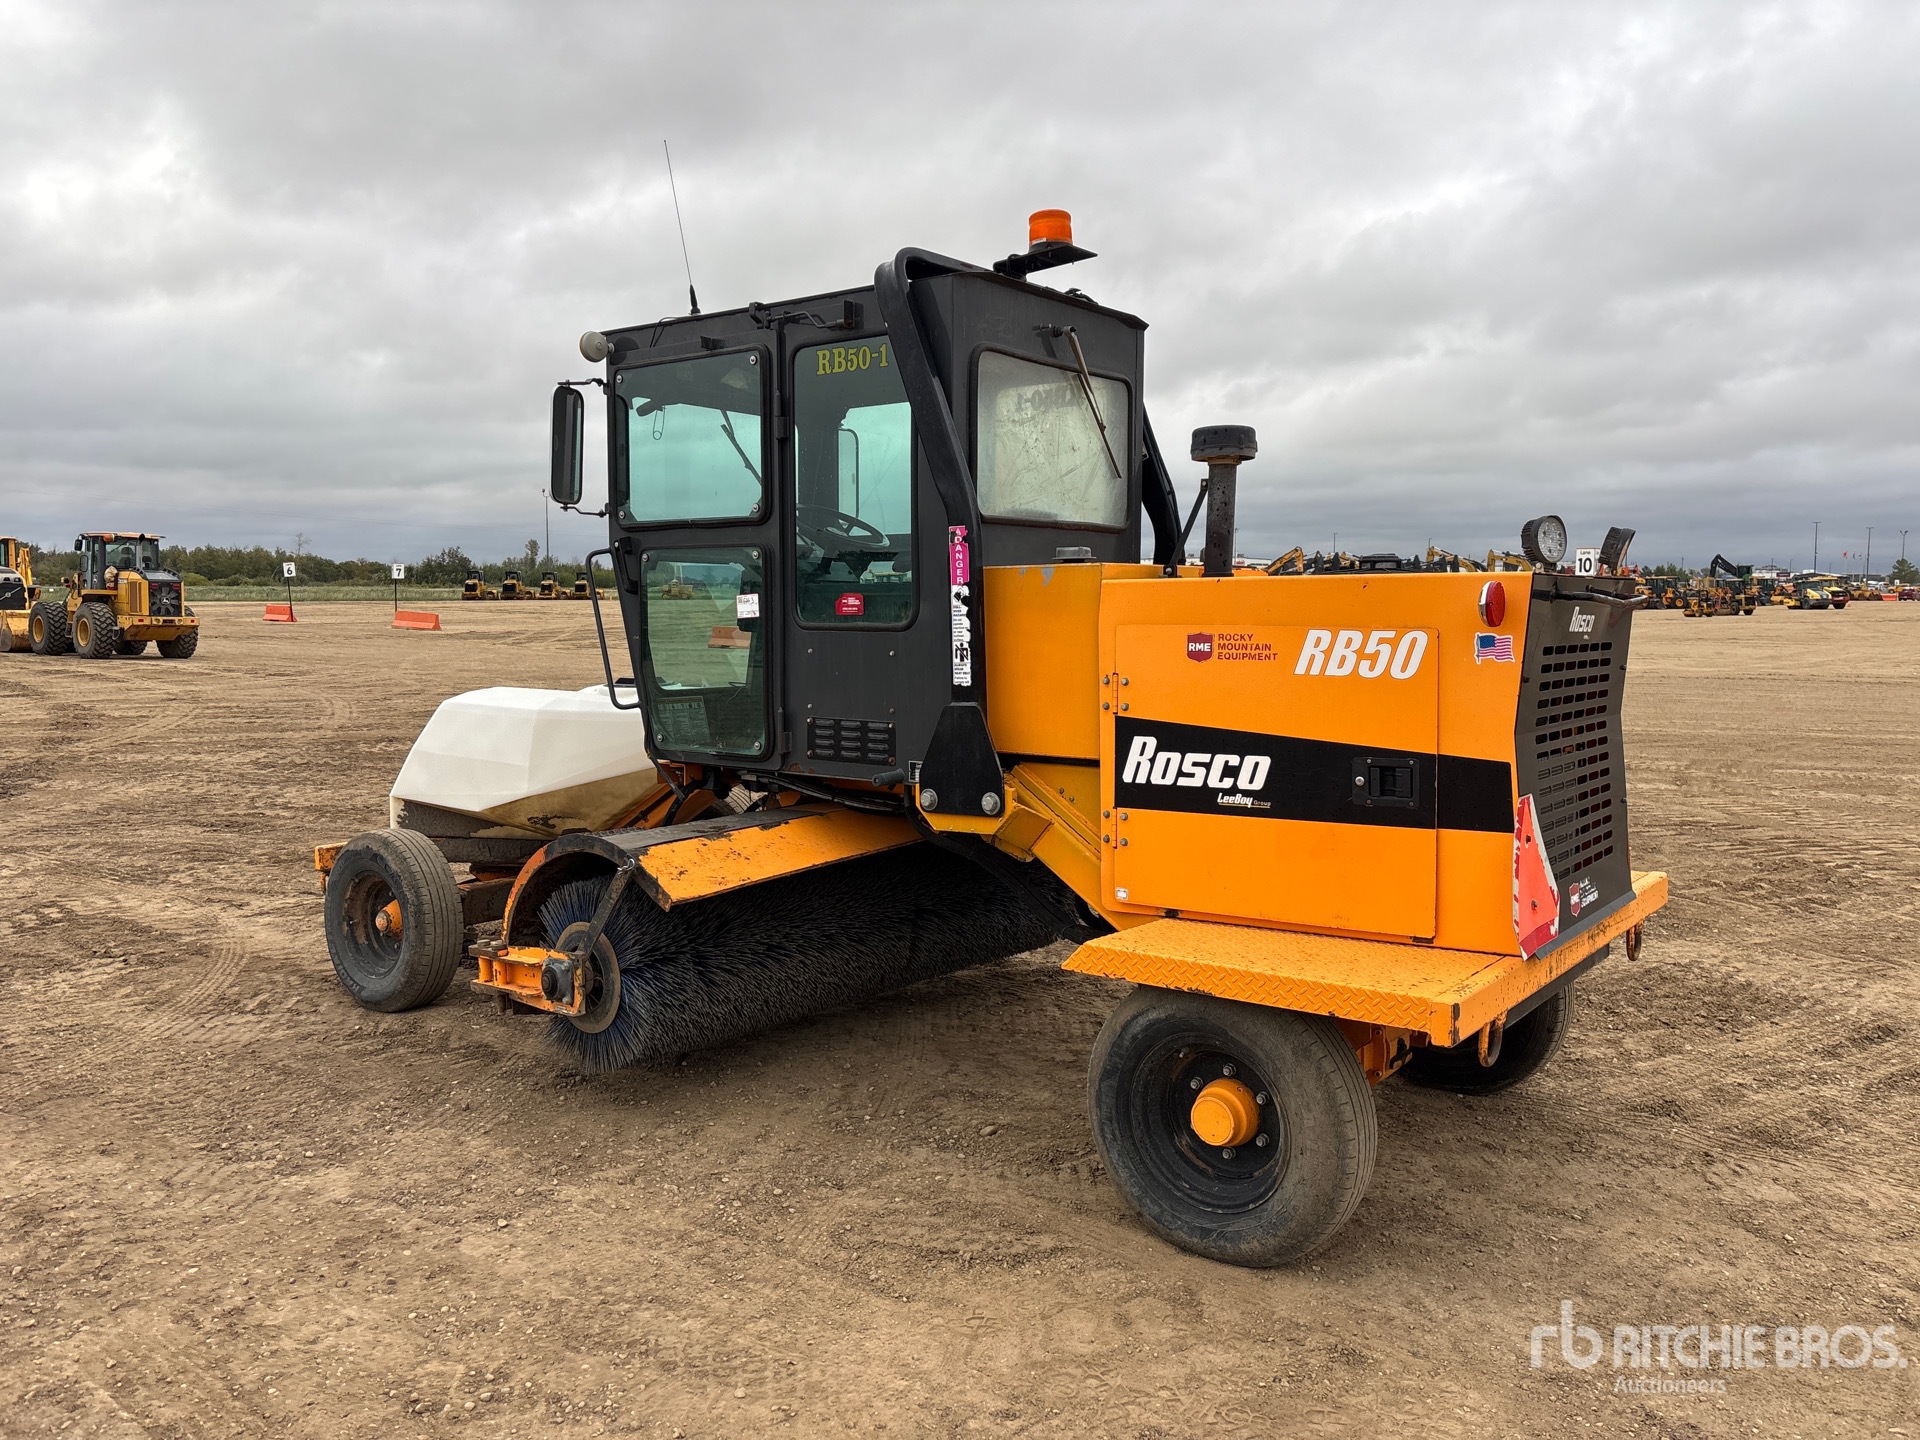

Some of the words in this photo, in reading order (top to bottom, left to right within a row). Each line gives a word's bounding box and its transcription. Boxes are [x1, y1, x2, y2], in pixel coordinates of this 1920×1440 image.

[816, 343, 888, 376] RB50-1
[954, 535, 964, 584] DANGER
[1577, 557, 1592, 573] 10
[286, 567, 293, 576] 6
[395, 568, 402, 577] 7
[1218, 633, 1254, 642] ROCKY
[1188, 642, 1212, 652] RME
[1217, 643, 1271, 652] MOUNTAIN
[1217, 652, 1278, 661] EQUIPMENT
[1293, 629, 1429, 680] RB50
[1217, 792, 1253, 808] LeeBoy
